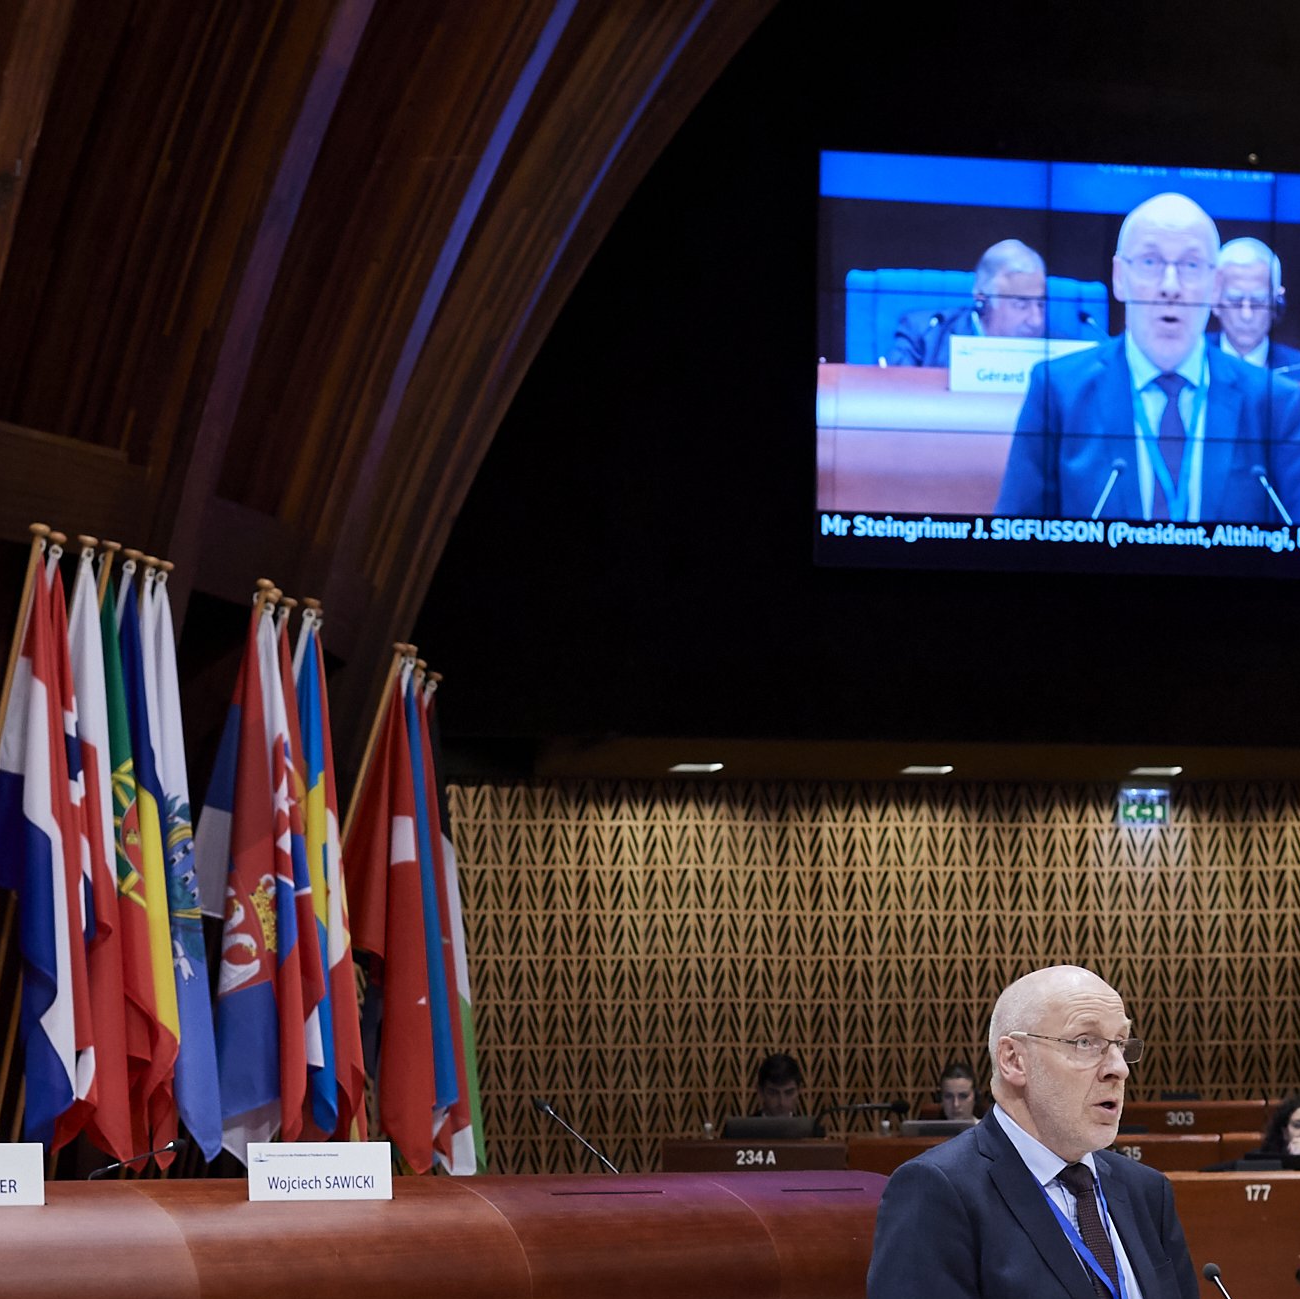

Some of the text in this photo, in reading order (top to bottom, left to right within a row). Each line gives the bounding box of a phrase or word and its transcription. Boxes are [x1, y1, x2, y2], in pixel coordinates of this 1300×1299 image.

[821, 514, 851, 536] Mr
[852, 515, 971, 542] Steingrimur
[972, 517, 989, 540] J.
[990, 518, 1104, 543] SIGFUSSON
[1107, 521, 1211, 548] (President,
[1211, 524, 1295, 553] Althingi,
[1166, 1111, 1195, 1126] 303
[268, 1175, 374, 1192] Wojciech SAWICKI
[1245, 1184, 1271, 1202] 177
